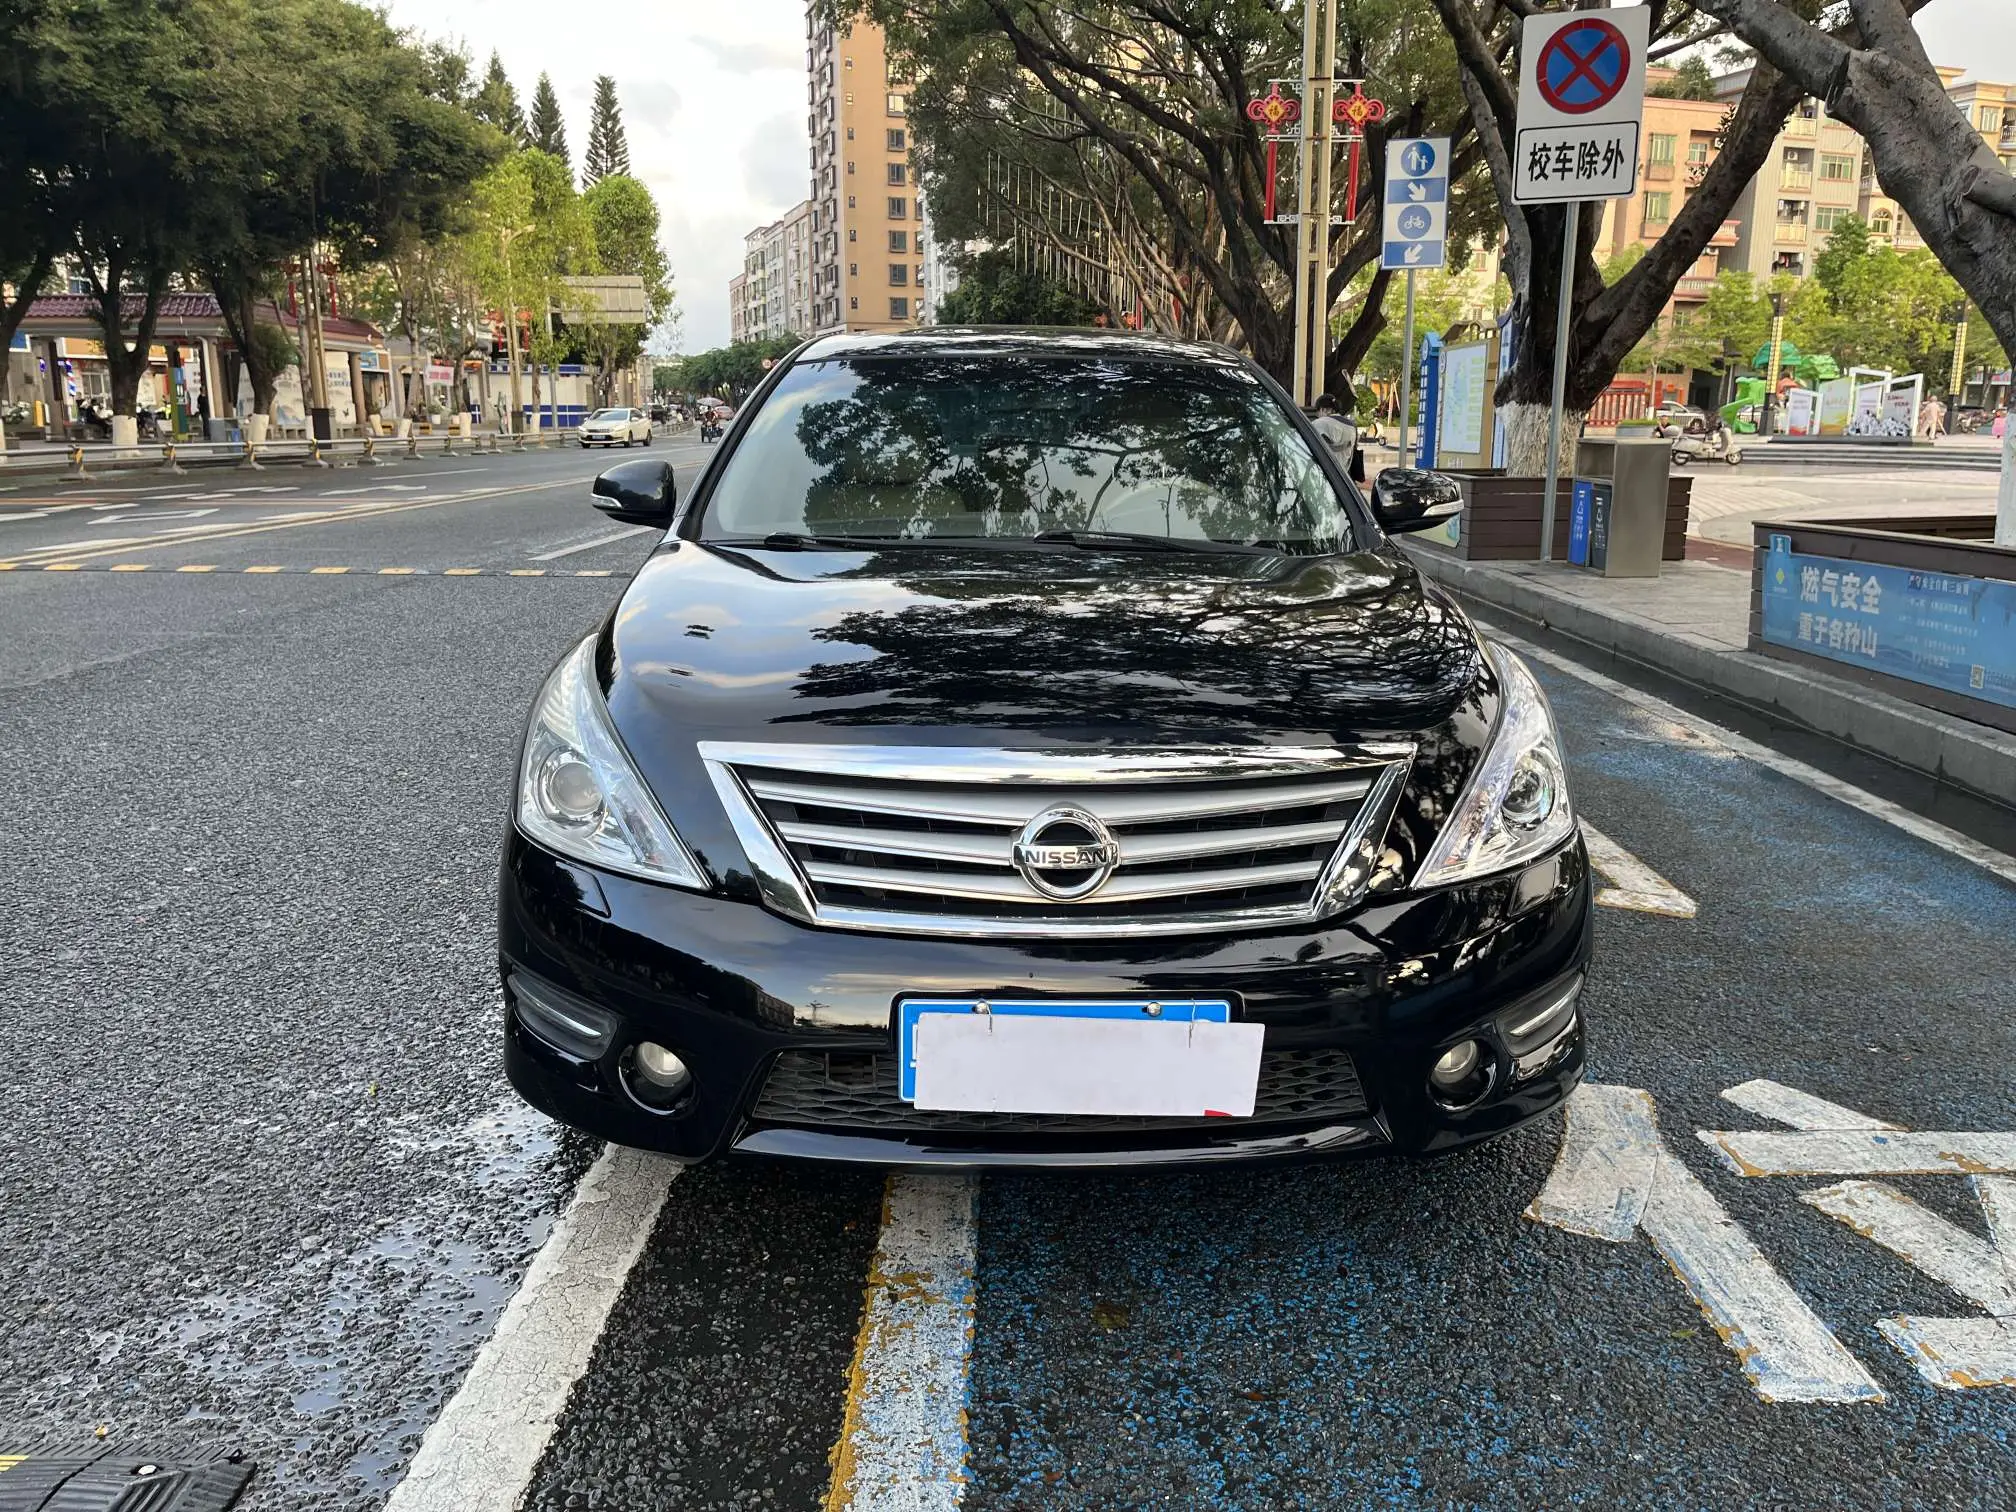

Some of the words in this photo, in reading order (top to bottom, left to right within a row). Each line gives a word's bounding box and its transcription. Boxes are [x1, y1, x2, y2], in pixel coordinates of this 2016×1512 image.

[1528, 138, 1625, 182] 校车除外
[1800, 565, 1882, 615] 燃气安全
[1025, 849, 1107, 864] NISSAN
